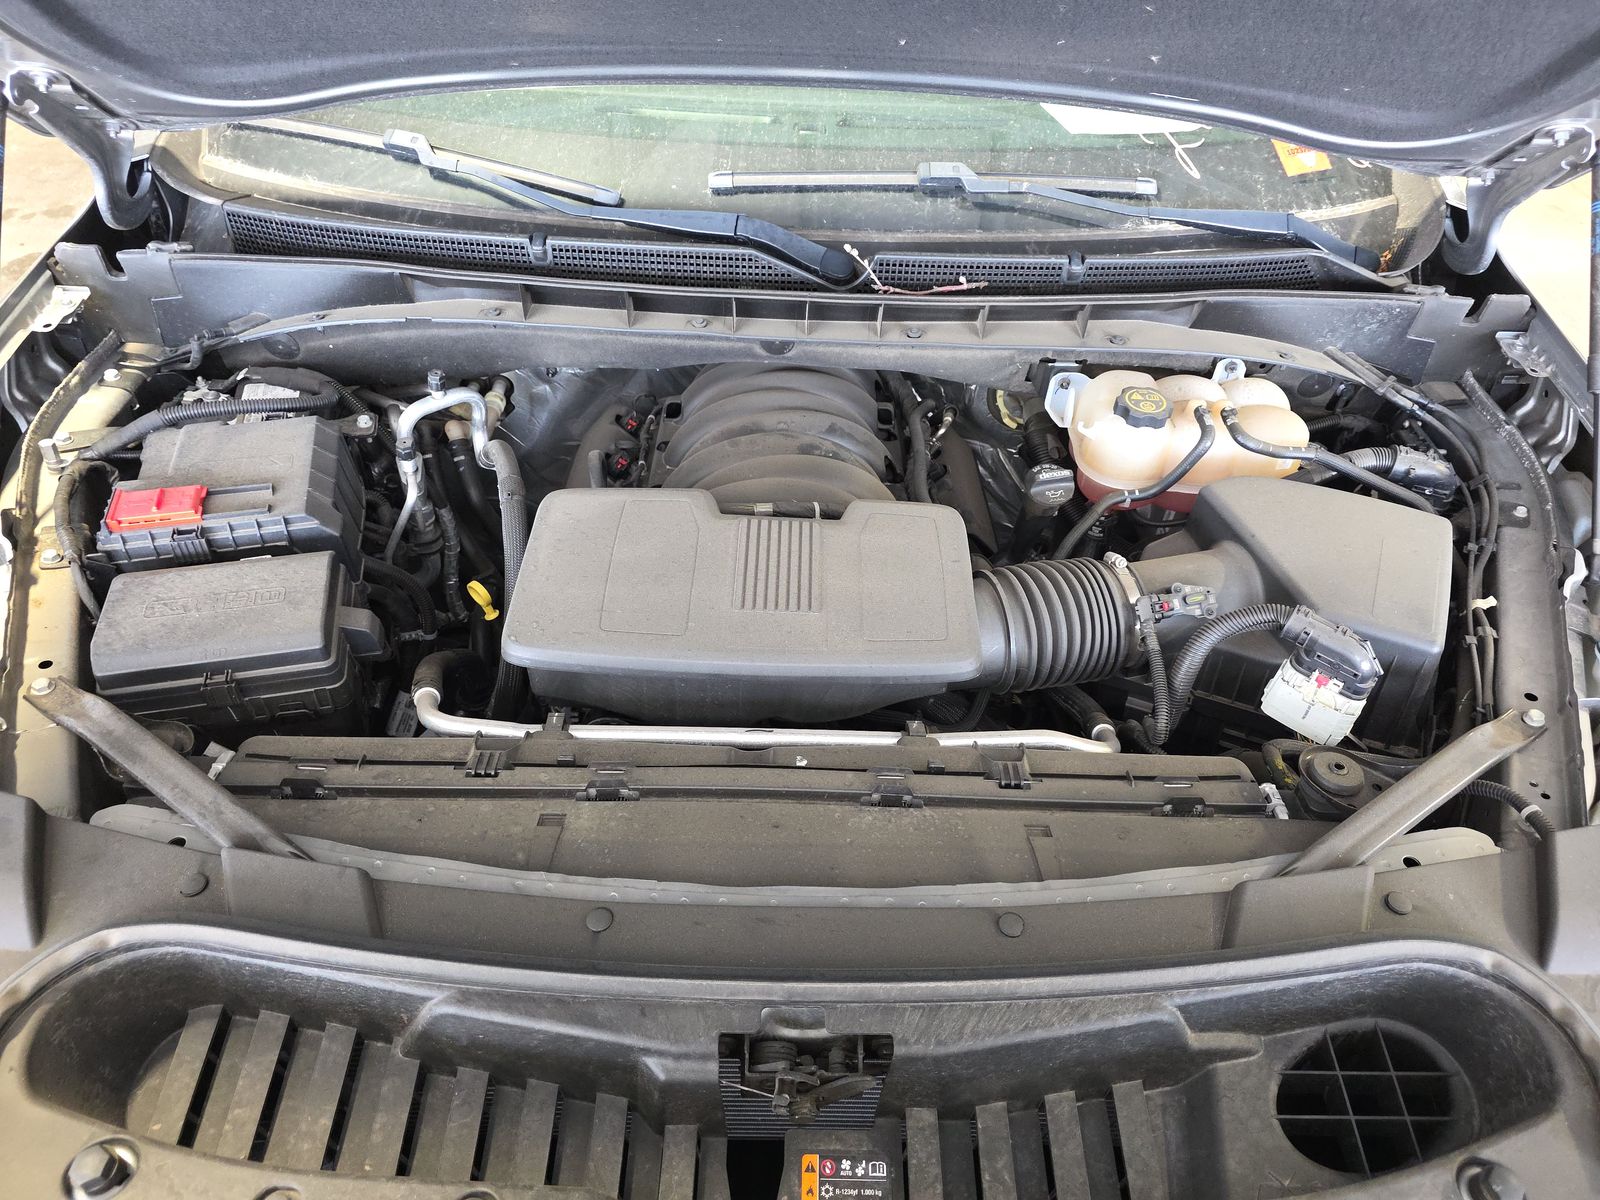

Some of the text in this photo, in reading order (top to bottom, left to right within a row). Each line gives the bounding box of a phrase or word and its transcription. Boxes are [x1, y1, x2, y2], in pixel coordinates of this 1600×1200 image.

[1039, 470, 1070, 479] dexos
[835, 1188, 858, 1196] R-1234yf
[875, 1189, 882, 1197] kg
